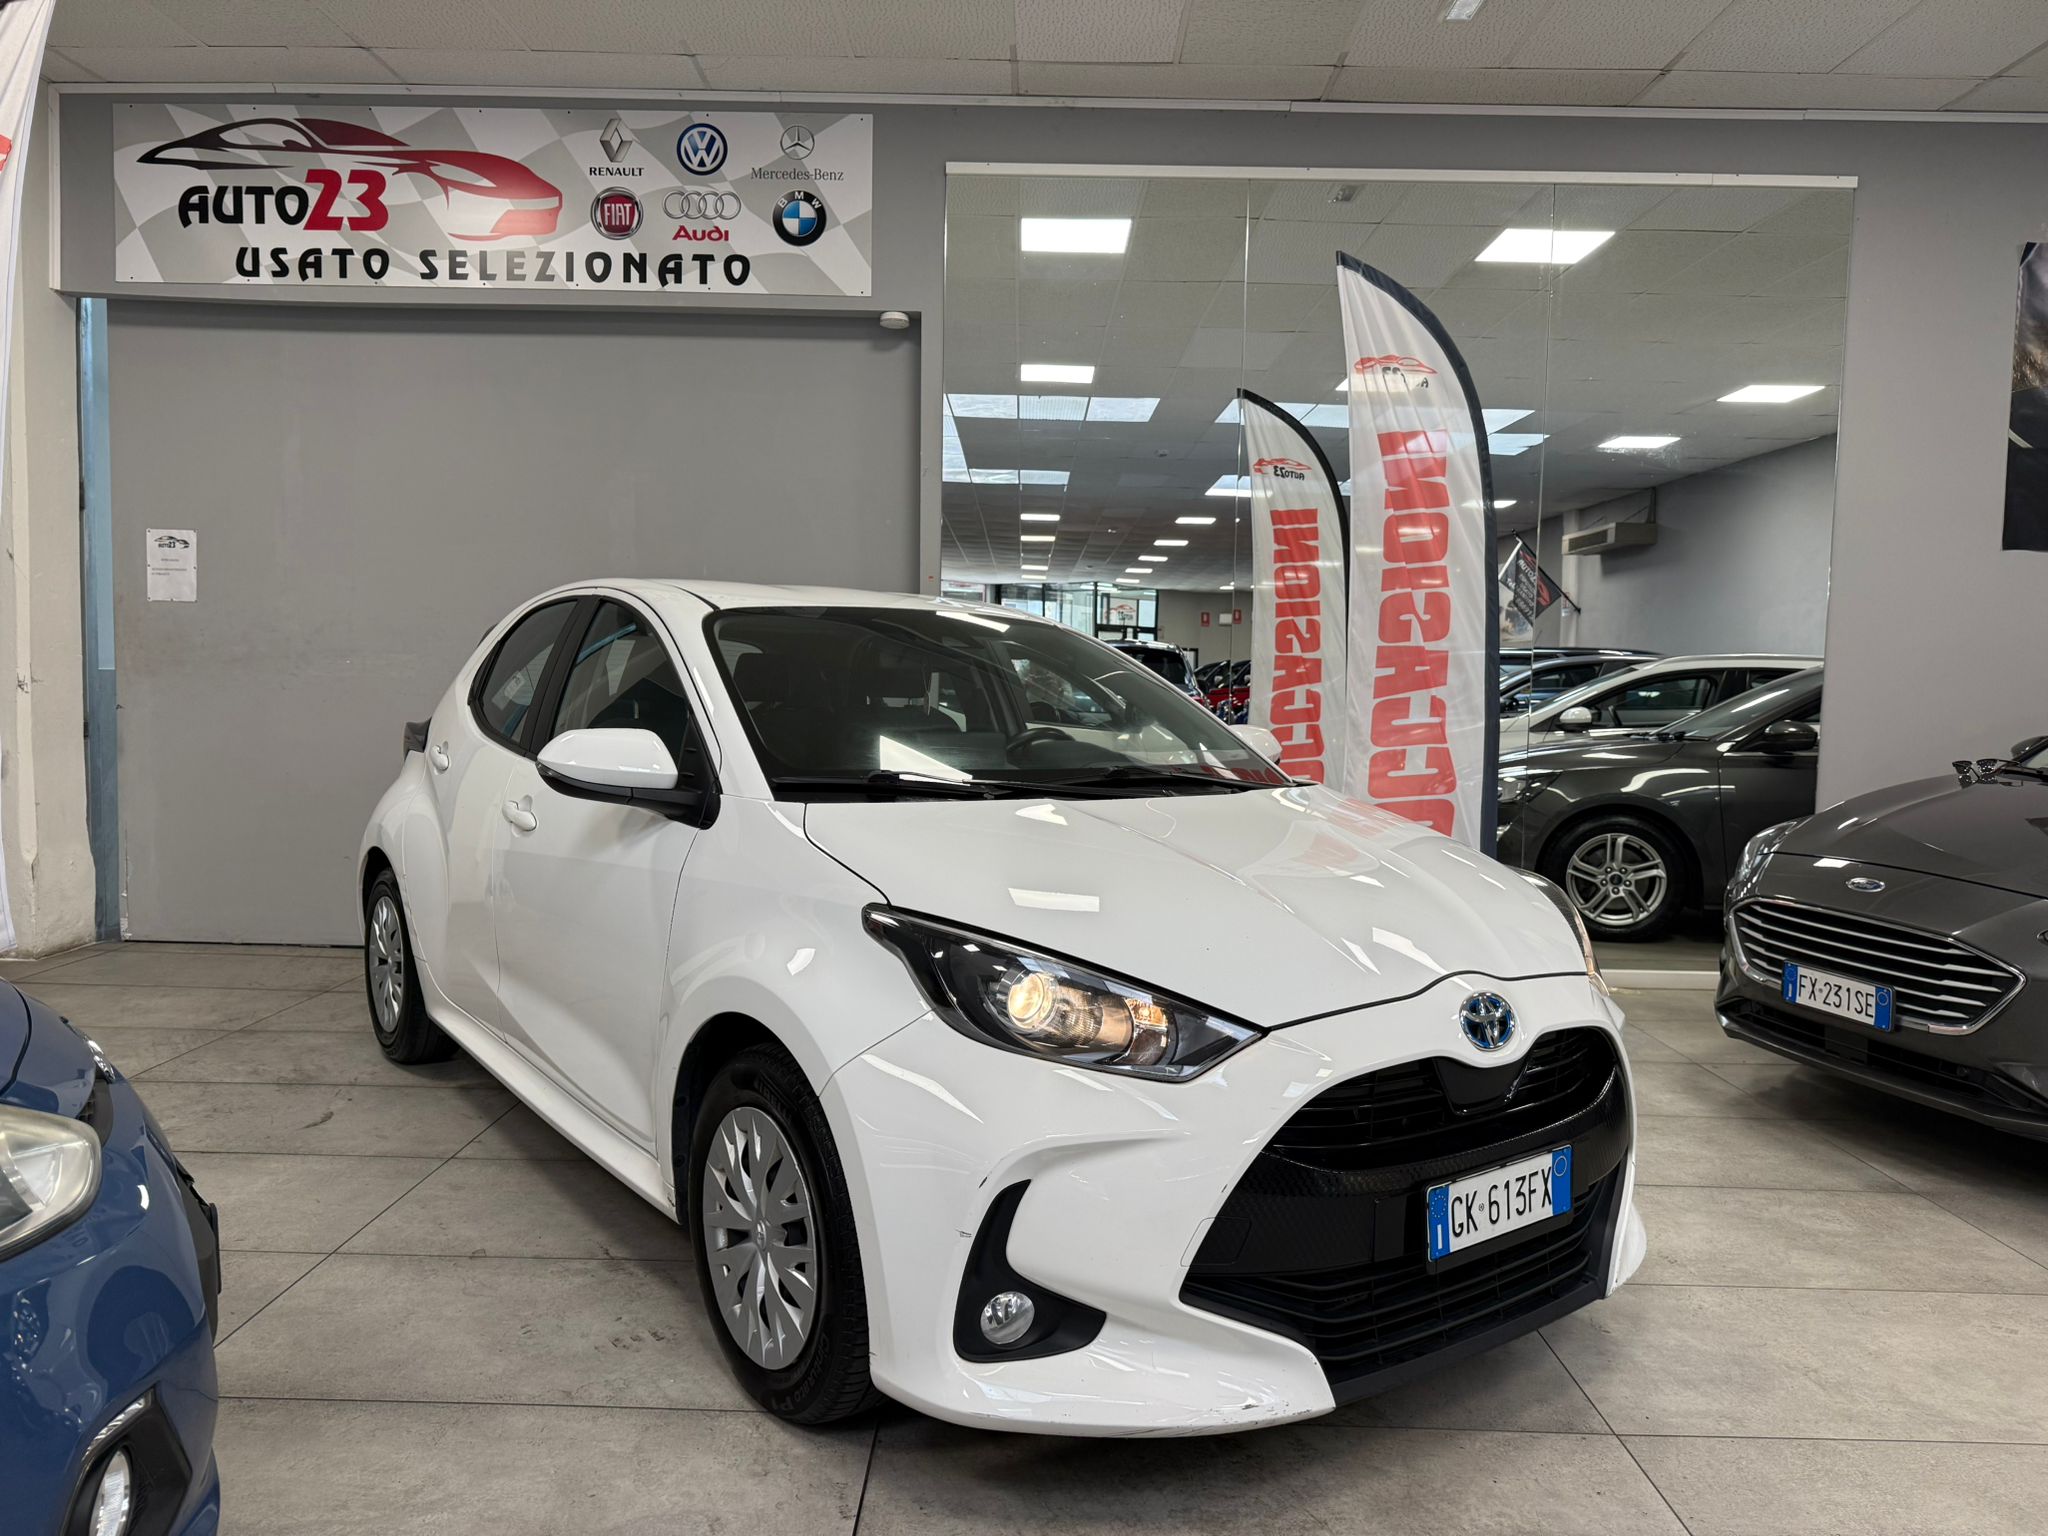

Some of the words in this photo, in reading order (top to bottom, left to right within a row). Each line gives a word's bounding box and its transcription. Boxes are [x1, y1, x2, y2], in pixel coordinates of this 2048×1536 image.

[589, 166, 645, 177] RENAULT
[750, 167, 844, 181] Mercedes-Benz
[177, 168, 389, 232] AUTO23
[777, 191, 822, 209] BMW
[603, 202, 632, 226] FIAT
[672, 225, 730, 242] Audi
[235, 246, 390, 282] USATO
[418, 249, 751, 288] SELEZIONATO
